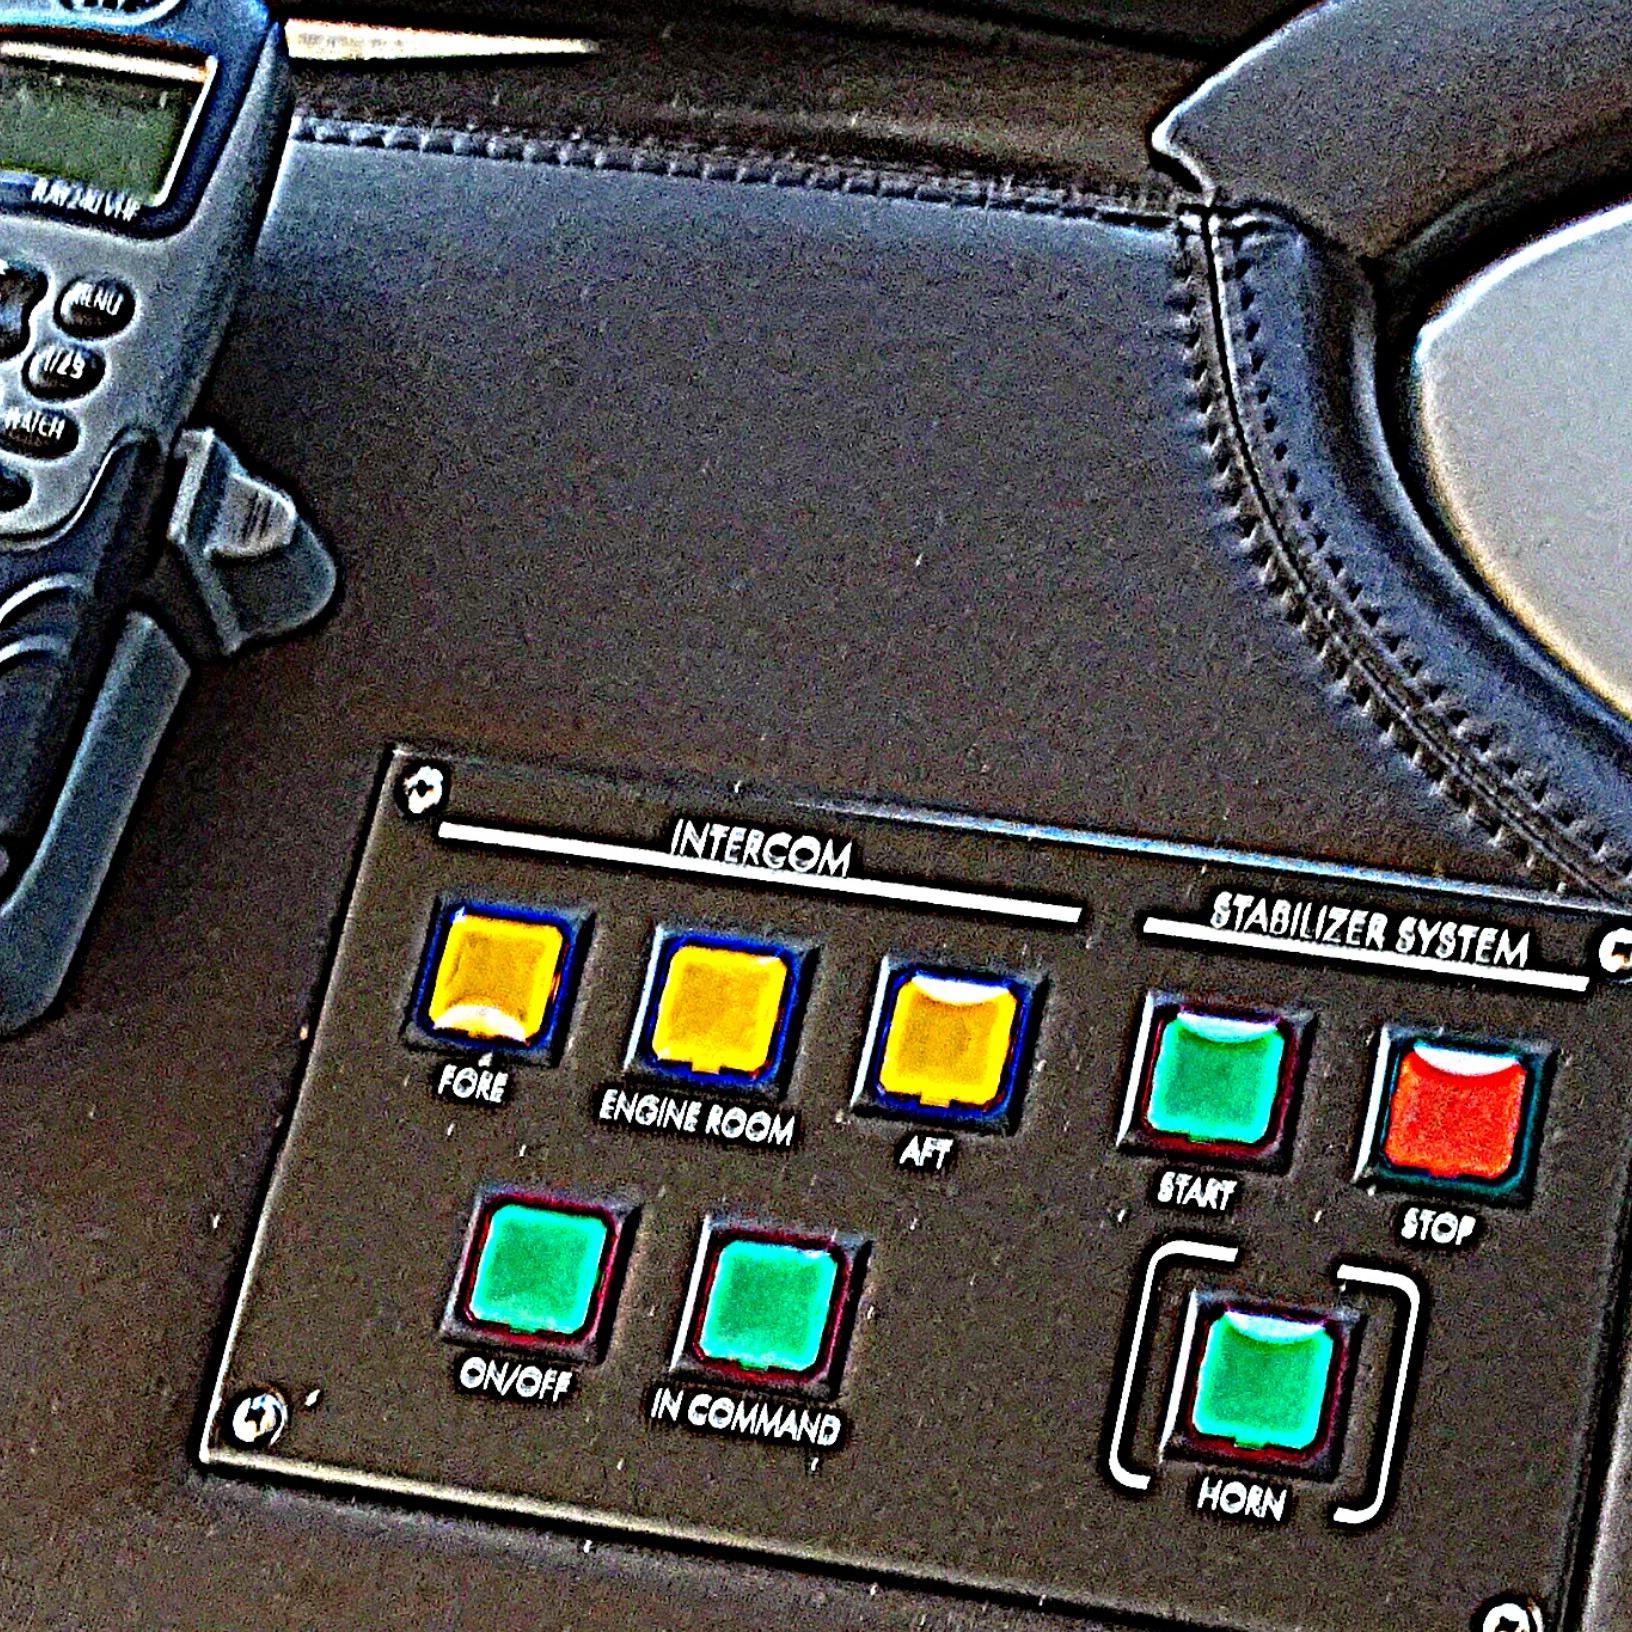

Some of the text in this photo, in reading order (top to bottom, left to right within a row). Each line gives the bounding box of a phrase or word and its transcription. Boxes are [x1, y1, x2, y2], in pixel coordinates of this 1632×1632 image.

[670, 818, 853, 878] INTERCOM
[1210, 890, 1530, 968] STABILIZER SYSTEM
[437, 1063, 509, 1104] FORE
[598, 1088, 796, 1147] ENGINE ROOM
[899, 1135, 954, 1170] AFT
[1157, 1170, 1238, 1212] START
[1400, 1206, 1477, 1246] STOP
[459, 1355, 571, 1403] ON/OFF
[651, 1387, 842, 1448] IN COMMAND
[1196, 1476, 1287, 1522] HORN
